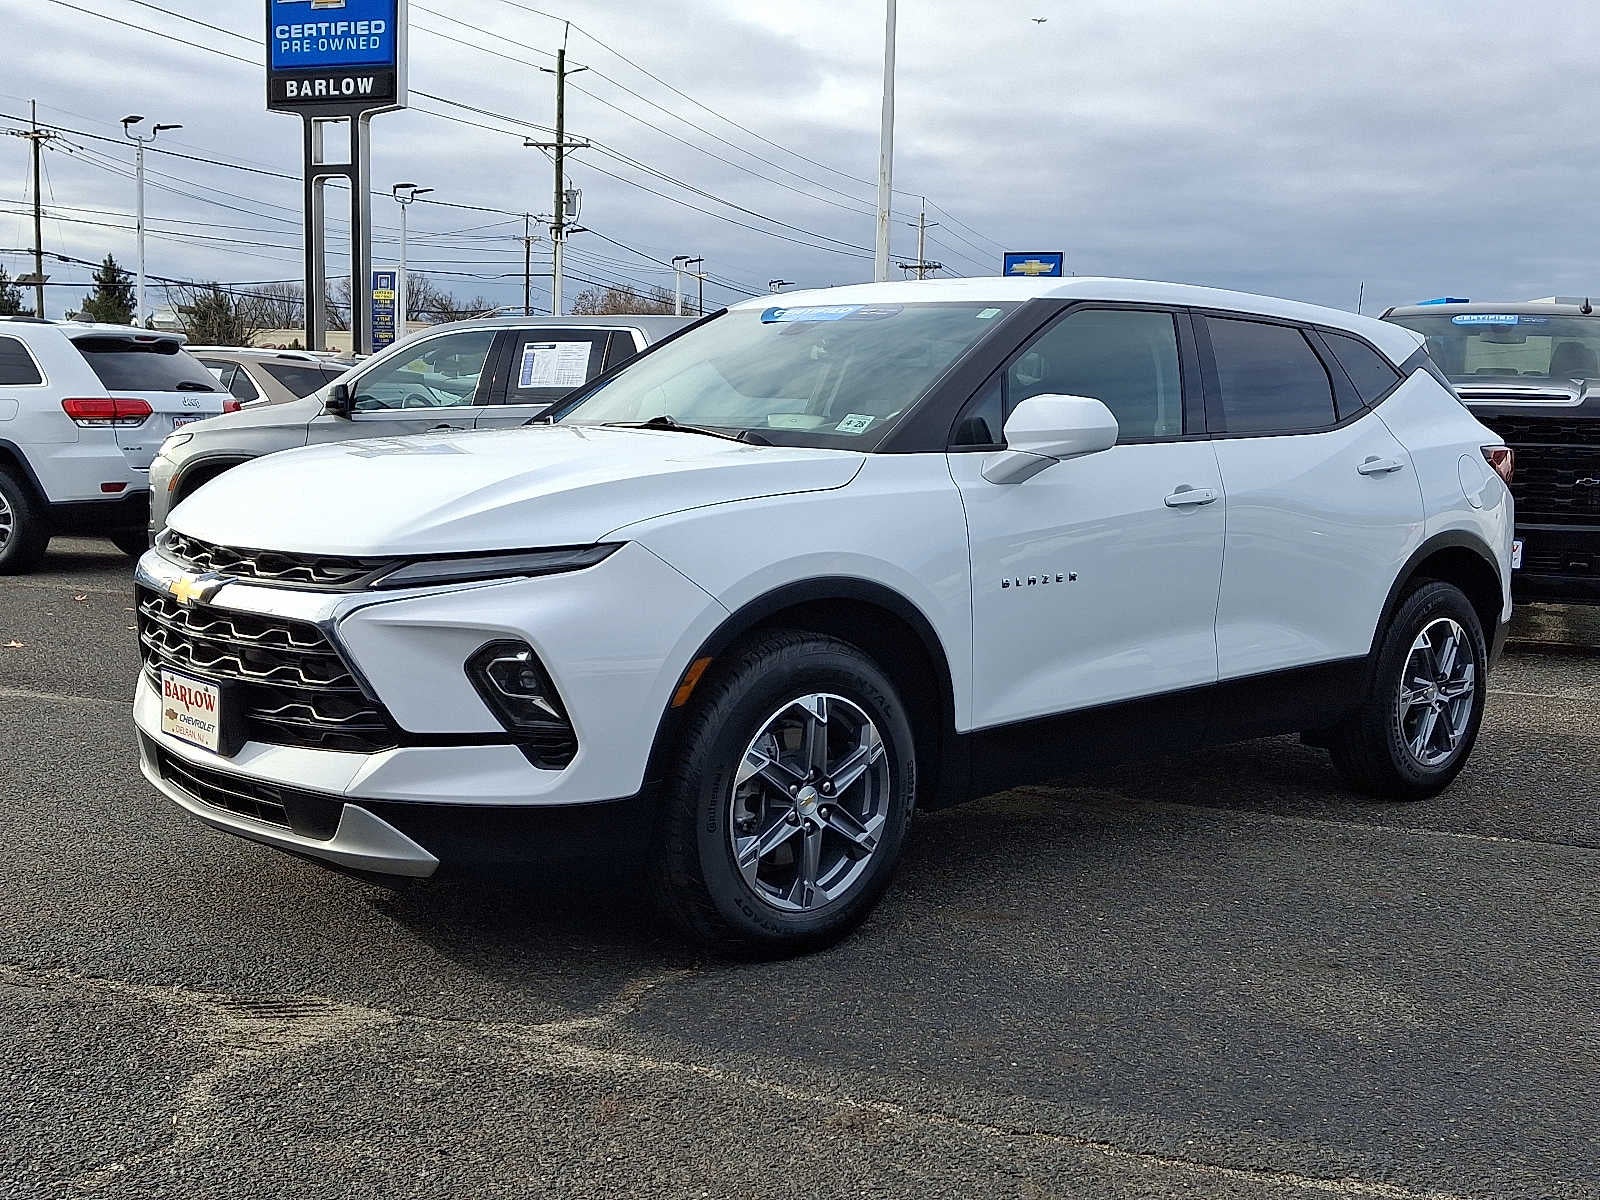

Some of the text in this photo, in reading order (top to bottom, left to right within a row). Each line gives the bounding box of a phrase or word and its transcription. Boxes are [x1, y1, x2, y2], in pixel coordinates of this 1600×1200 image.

[275, 20, 386, 39] CERTIFIED
[281, 36, 380, 54] PRE-OWNED
[286, 77, 374, 98] BARLOW
[182, 397, 201, 409] Jeep
[1001, 572, 1078, 589] BLAZER
[164, 680, 216, 713] BARLOW
[179, 714, 216, 734] CHEVROLET
